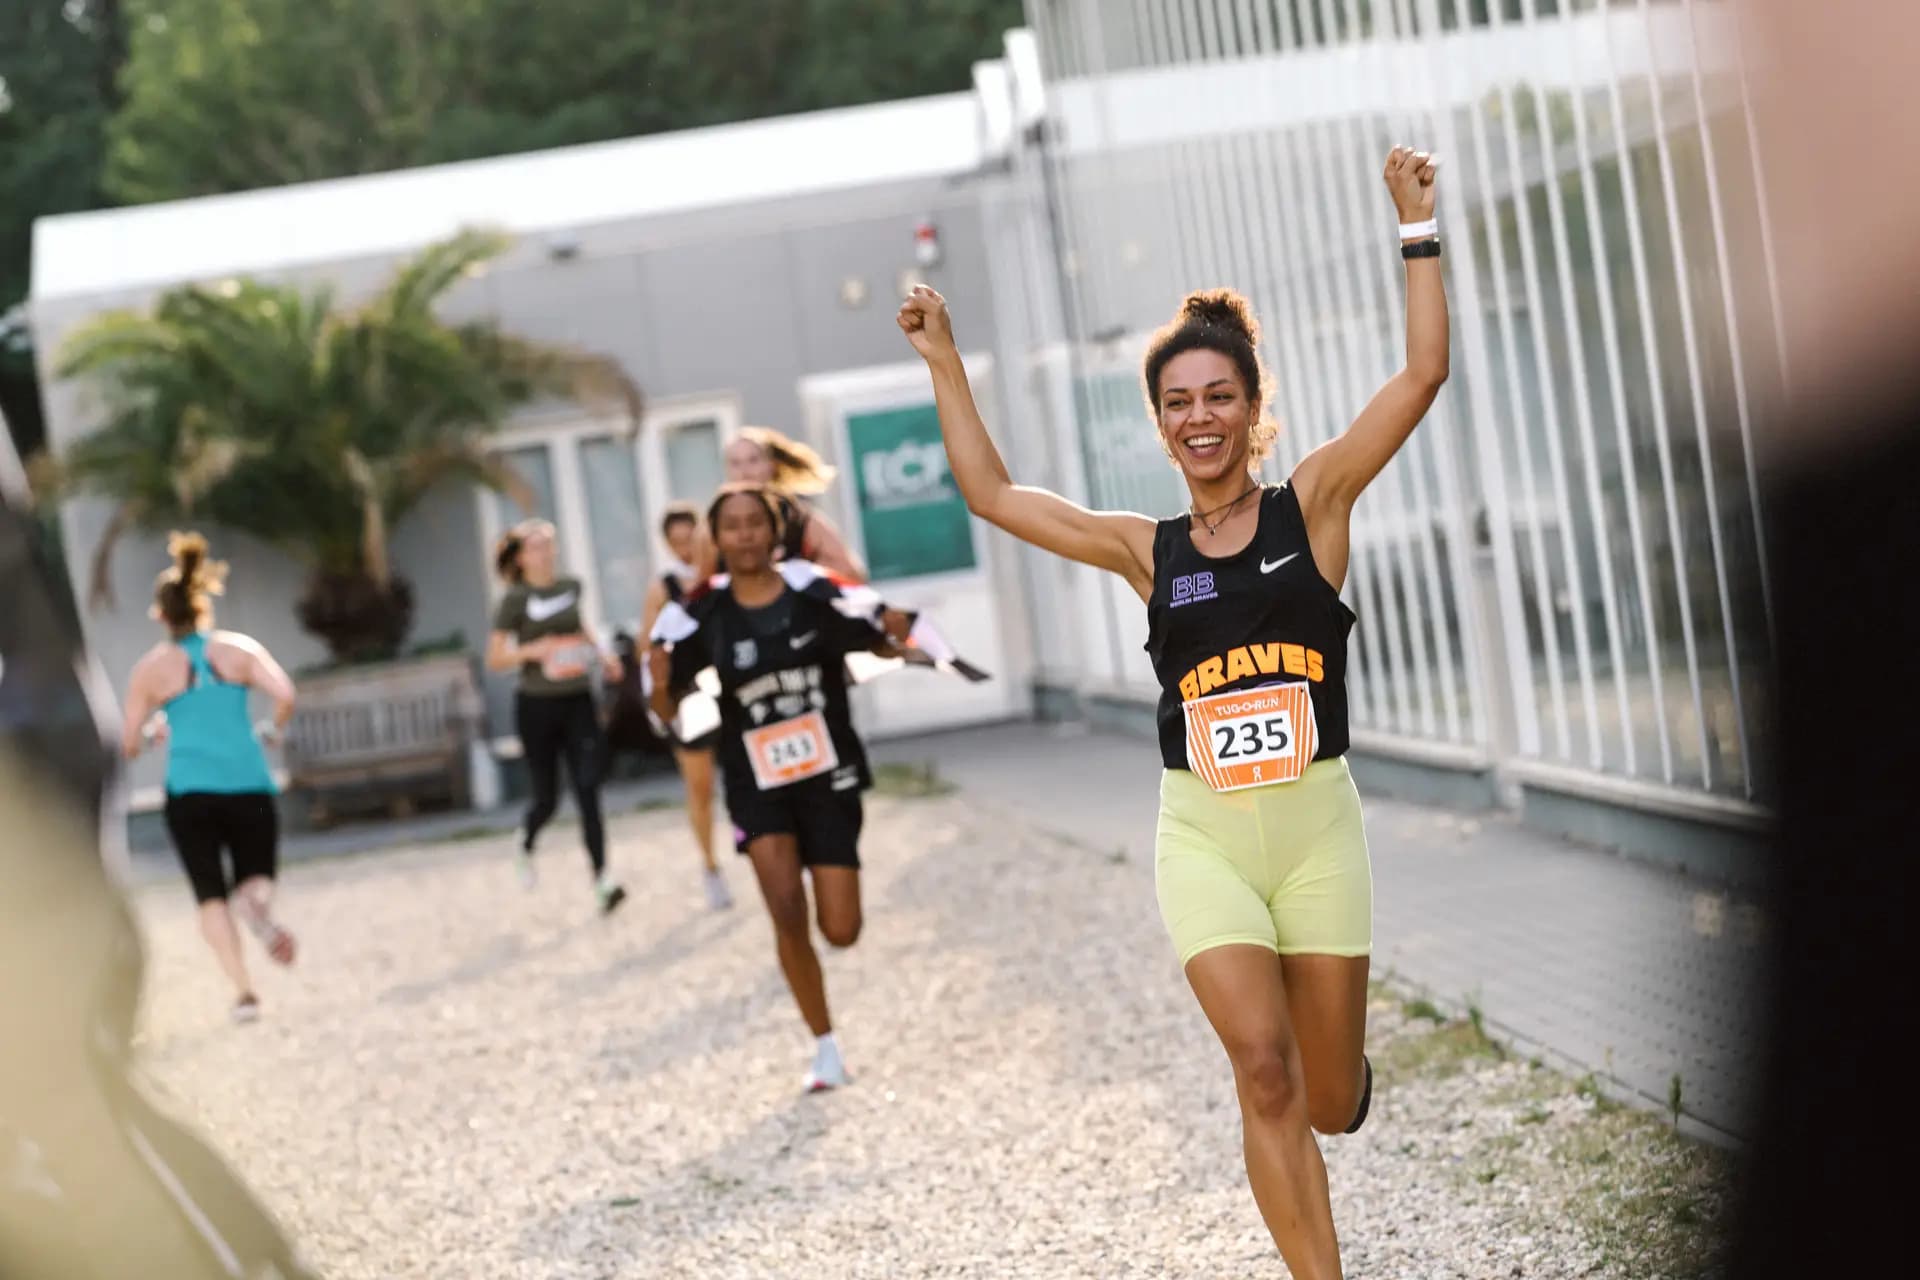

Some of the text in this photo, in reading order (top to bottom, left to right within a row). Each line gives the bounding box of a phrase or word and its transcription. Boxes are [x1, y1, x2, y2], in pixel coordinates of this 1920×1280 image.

[1173, 571, 1214, 600] BB
[1179, 642, 1324, 701] BRAVES
[1215, 697, 1280, 716] TUG-O-RUN
[1215, 718, 1288, 759] 235
